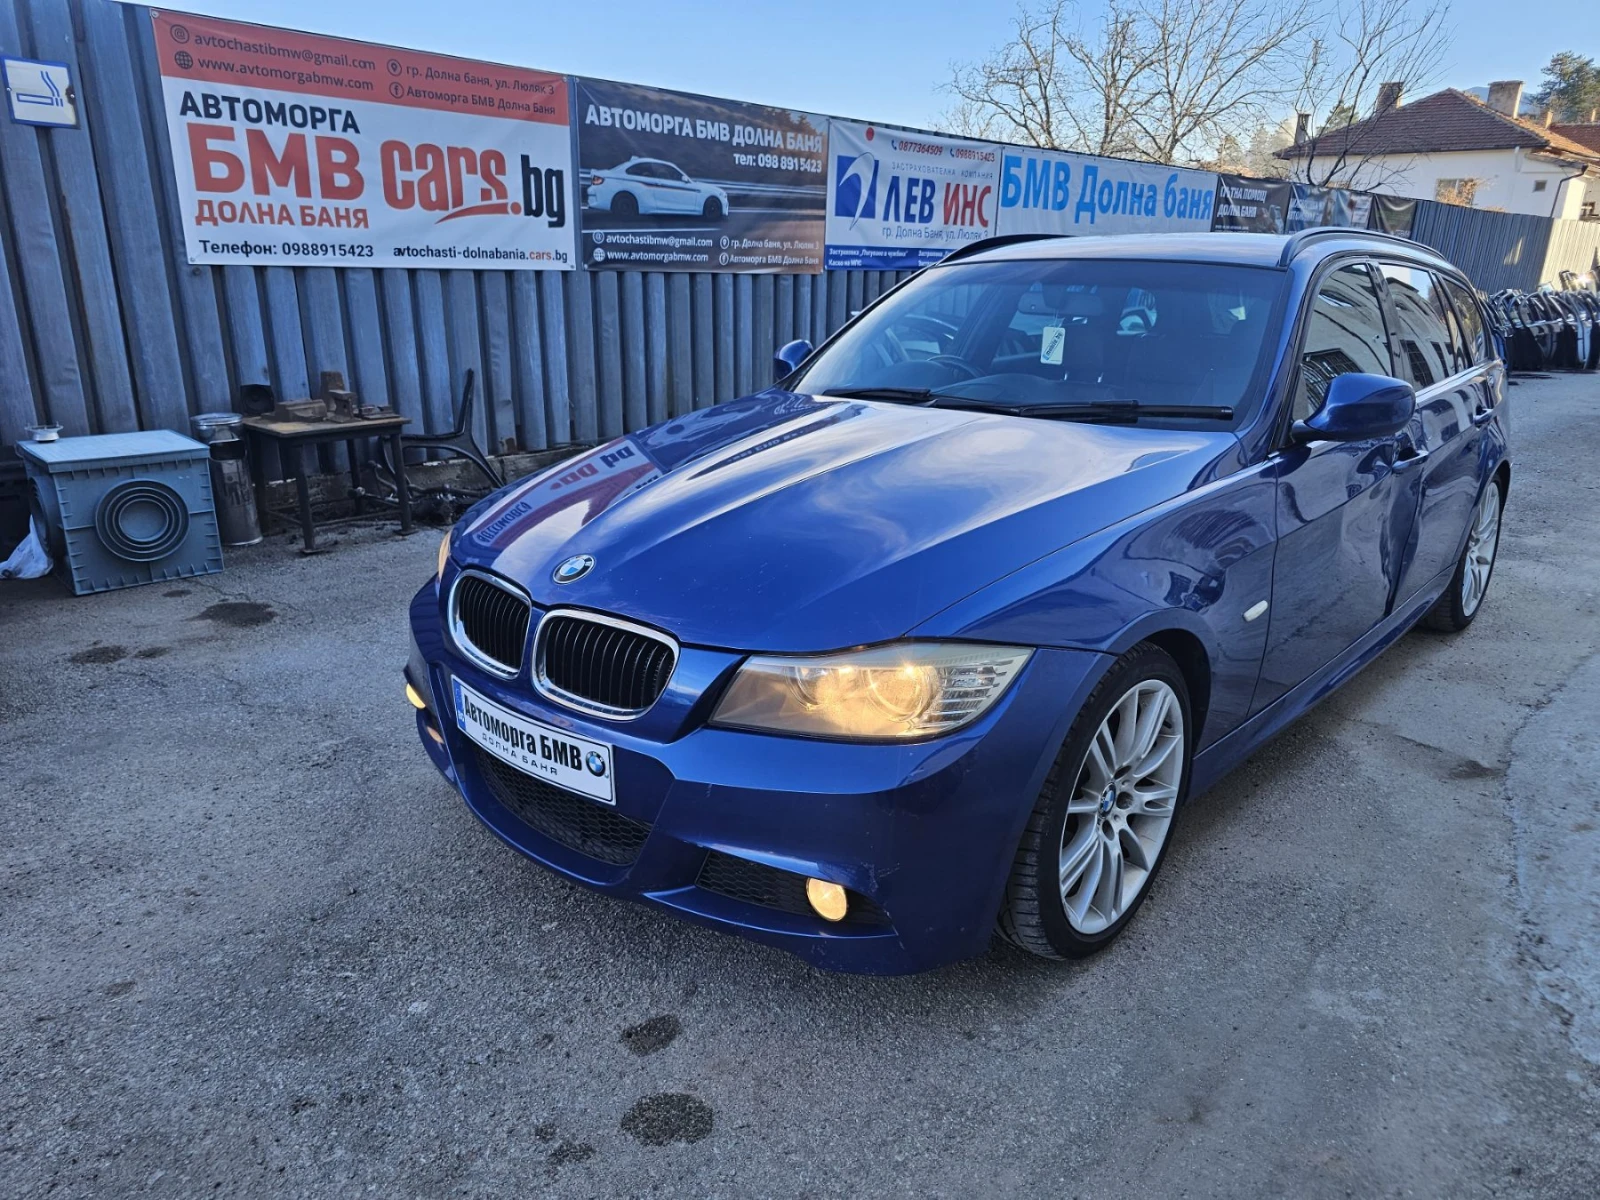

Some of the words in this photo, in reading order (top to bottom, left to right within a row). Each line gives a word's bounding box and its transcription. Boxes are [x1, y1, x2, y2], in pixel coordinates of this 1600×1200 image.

[194, 33, 376, 70] avtochastibmw@gmail.com
[198, 57, 374, 91] www.avtomorgabmw.com
[406, 65, 421, 79] гр.
[425, 66, 461, 82] Долна
[495, 78, 510, 90] ул.
[512, 80, 546, 93] Люляк
[549, 85, 555, 95] 3
[180, 91, 361, 134] АВТОМОРГА
[406, 86, 469, 104] Автоморга
[471, 95, 496, 107] БМВ
[498, 98, 531, 111] Долна
[533, 102, 556, 115] Баня
[585, 105, 693, 137] АВТОМОРГА
[696, 119, 730, 142] БМВ
[732, 125, 783, 148] ДОЛНА
[786, 133, 823, 153] БАНЯ
[186, 122, 365, 201] БМВ
[733, 153, 756, 166] тел:
[758, 153, 778, 168] 098
[898, 140, 943, 156] 0877364509
[955, 148, 995, 162] 0988915423
[380, 139, 566, 229] cars.bg
[1000, 155, 1071, 212] БМВ
[1074, 165, 1158, 225] Долна
[1164, 173, 1214, 221] баня
[195, 199, 295, 227] ДОЛНА
[299, 205, 369, 229] БАНЯ
[882, 175, 936, 224] ЛЕВ
[943, 182, 992, 228] ИНС
[606, 233, 713, 248] avtochastibmw@gmail.com
[895, 226, 922, 239] Долна
[199, 240, 277, 257] Телефон:
[281, 242, 374, 257] 0988915423
[393, 245, 568, 263] avtochasti-dolnabania.cars.bg
[606, 251, 709, 263] www.avtomorgabmw.com
[729, 254, 766, 265] Автоморга
[463, 694, 537, 755] Автоморга
[540, 734, 582, 771] БМВ
[482, 732, 517, 759] ДОЛНА
[522, 755, 558, 776] БАНЯ
